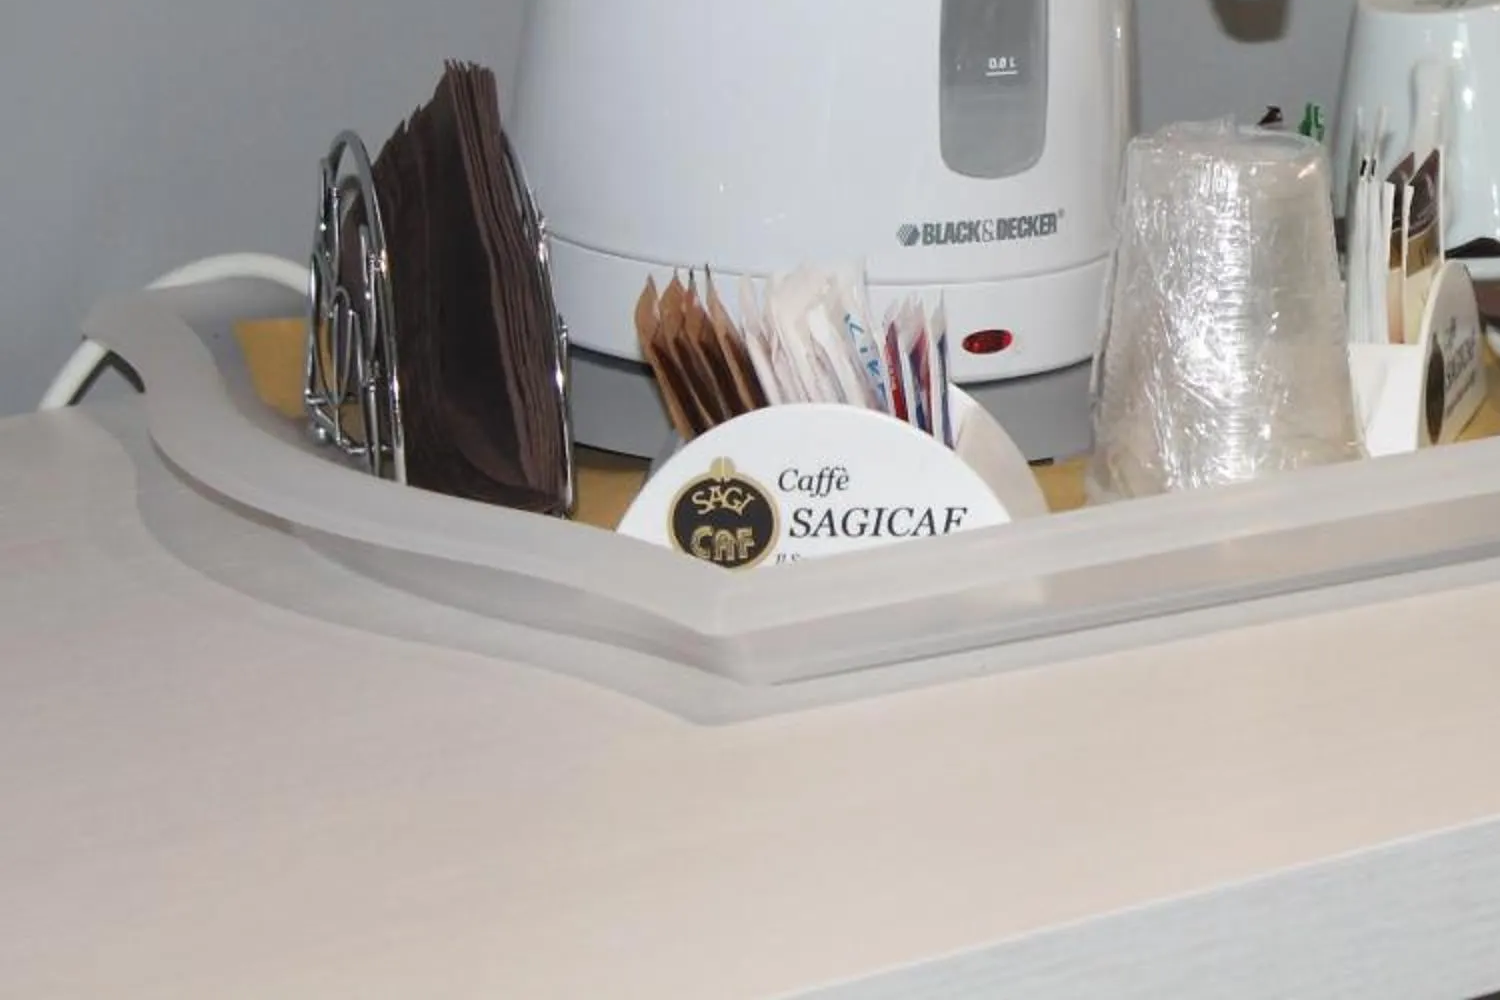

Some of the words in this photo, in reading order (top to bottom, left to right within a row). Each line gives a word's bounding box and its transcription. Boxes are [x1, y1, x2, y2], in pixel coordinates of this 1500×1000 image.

[777, 466, 850, 498] Caffè
[691, 484, 754, 516] SAGI
[690, 525, 756, 562] CAF
